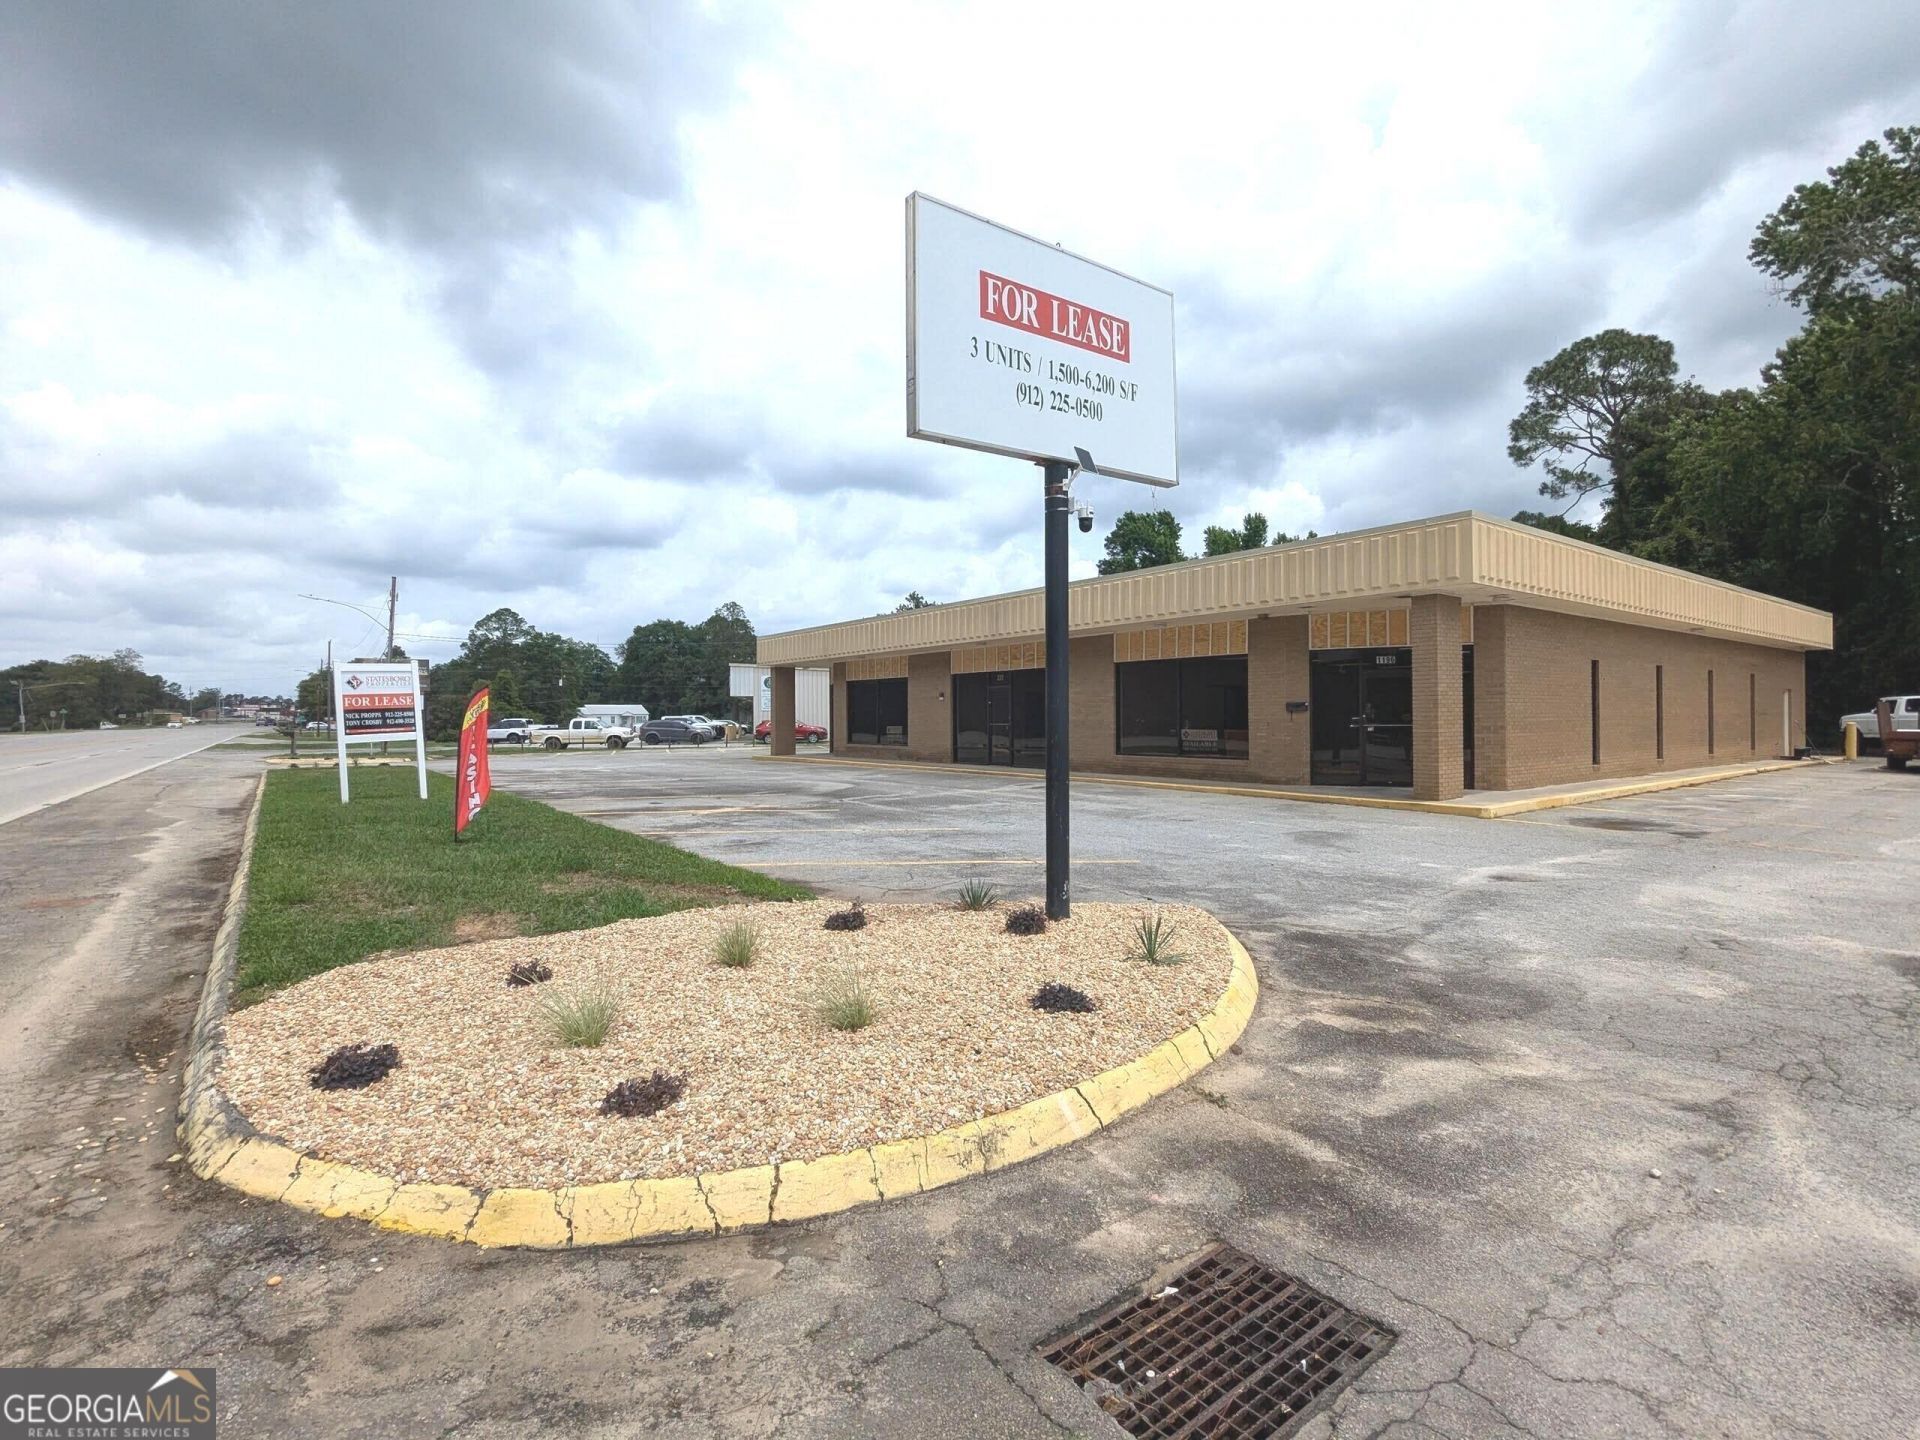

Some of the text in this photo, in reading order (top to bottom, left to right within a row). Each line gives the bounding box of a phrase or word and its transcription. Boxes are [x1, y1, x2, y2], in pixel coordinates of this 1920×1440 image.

[985, 277, 1125, 355] FOR LEASE
[970, 336, 1138, 402] 3 UNITS / 1,500-6,200 S/F
[1016, 382, 1103, 422] (912) 225-0500
[344, 696, 414, 707] FOR LEASE
